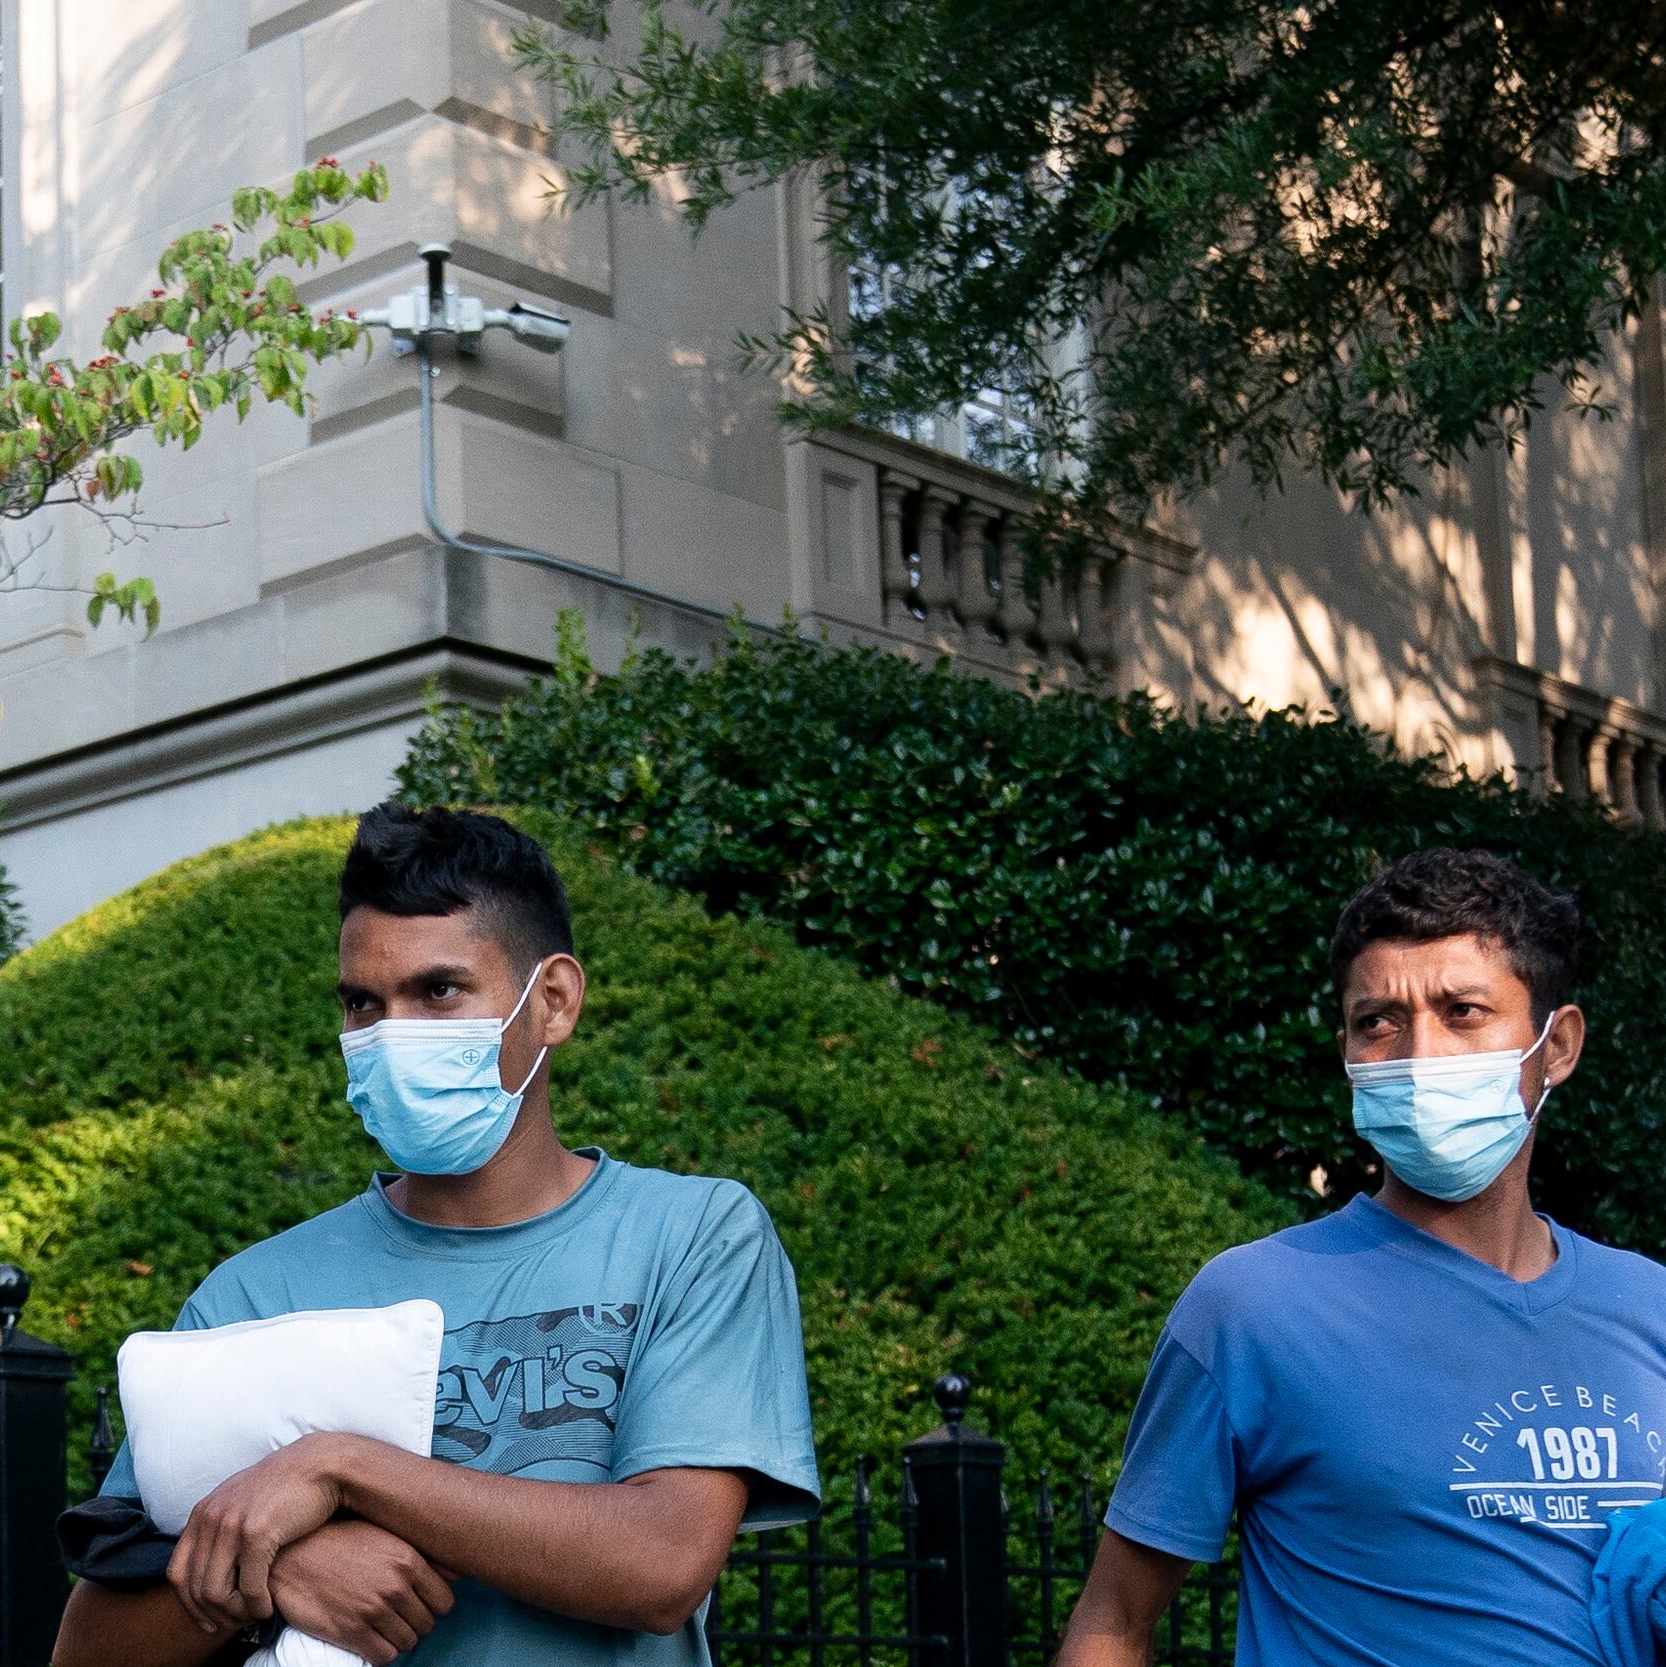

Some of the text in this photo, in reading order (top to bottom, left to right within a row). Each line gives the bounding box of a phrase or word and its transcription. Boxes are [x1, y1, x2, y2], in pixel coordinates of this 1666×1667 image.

[1452, 1384, 1562, 1475] VENICE
[1516, 1426, 1617, 1480] 1987
[1466, 1493, 1591, 1520] OCEAN SIDE
